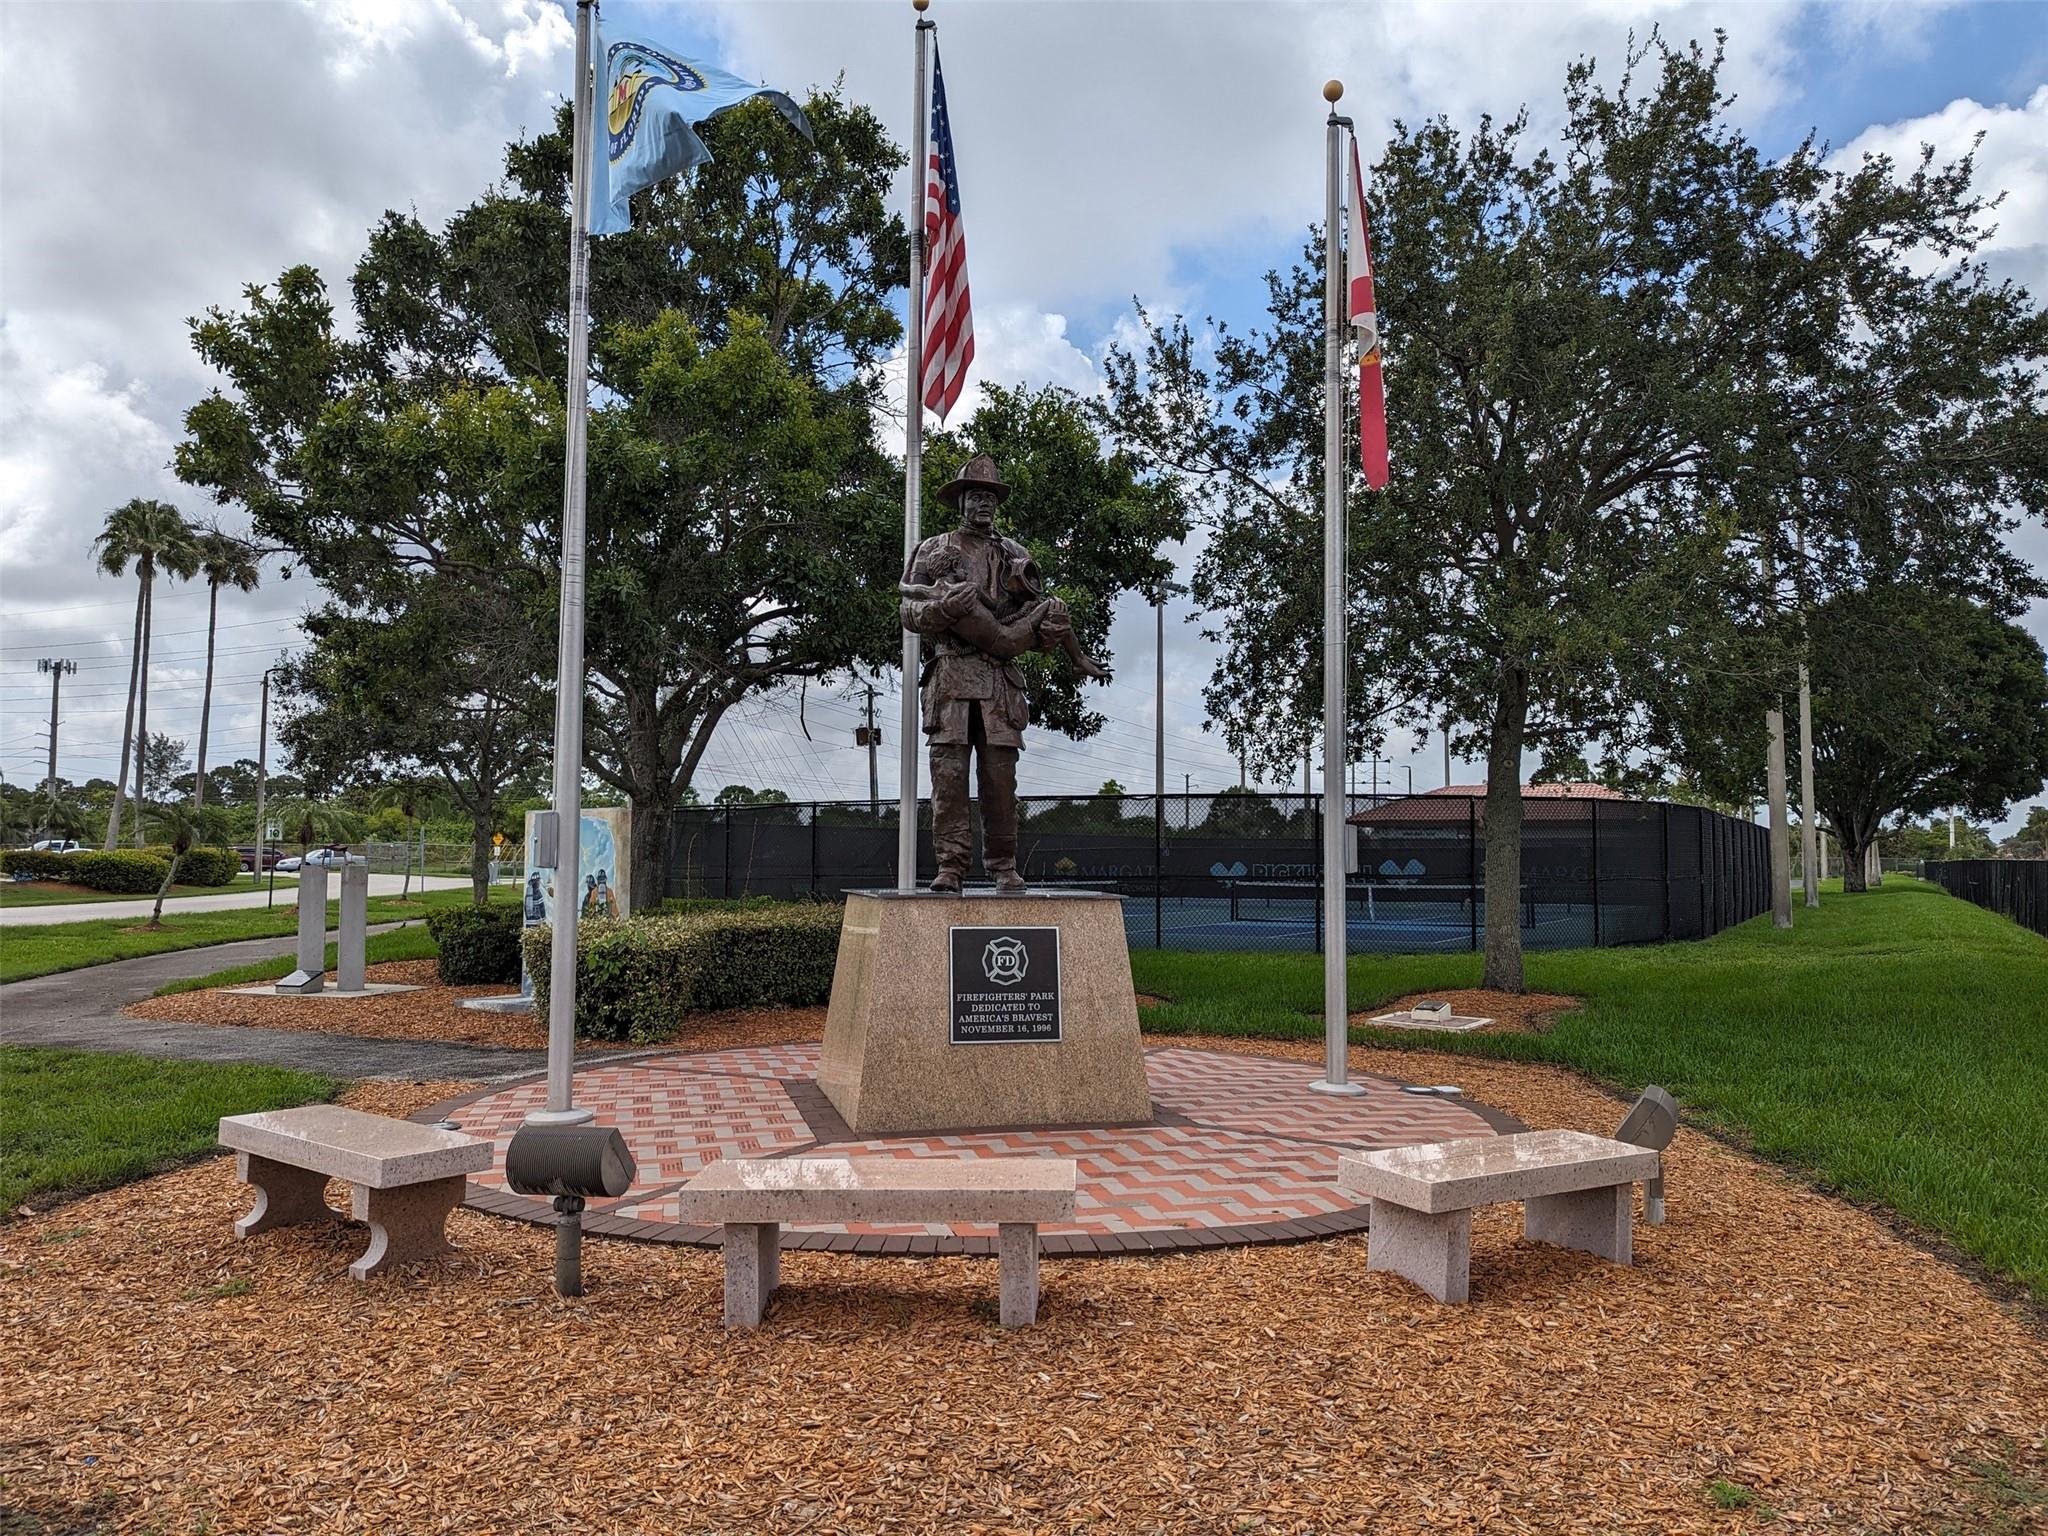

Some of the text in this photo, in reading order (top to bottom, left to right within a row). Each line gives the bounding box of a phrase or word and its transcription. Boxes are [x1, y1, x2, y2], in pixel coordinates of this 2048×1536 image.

[269, 829, 280, 838] 10
[997, 955, 1015, 966] FD
[957, 991, 1055, 1001] FIREFIGHTERS' PARK
[971, 1002, 1041, 1012] DEDICATED TO
[958, 1013, 1054, 1023] AMERICA'S BRAVEST
[960, 1023, 1052, 1034] NOVEMBER 16, 1996
